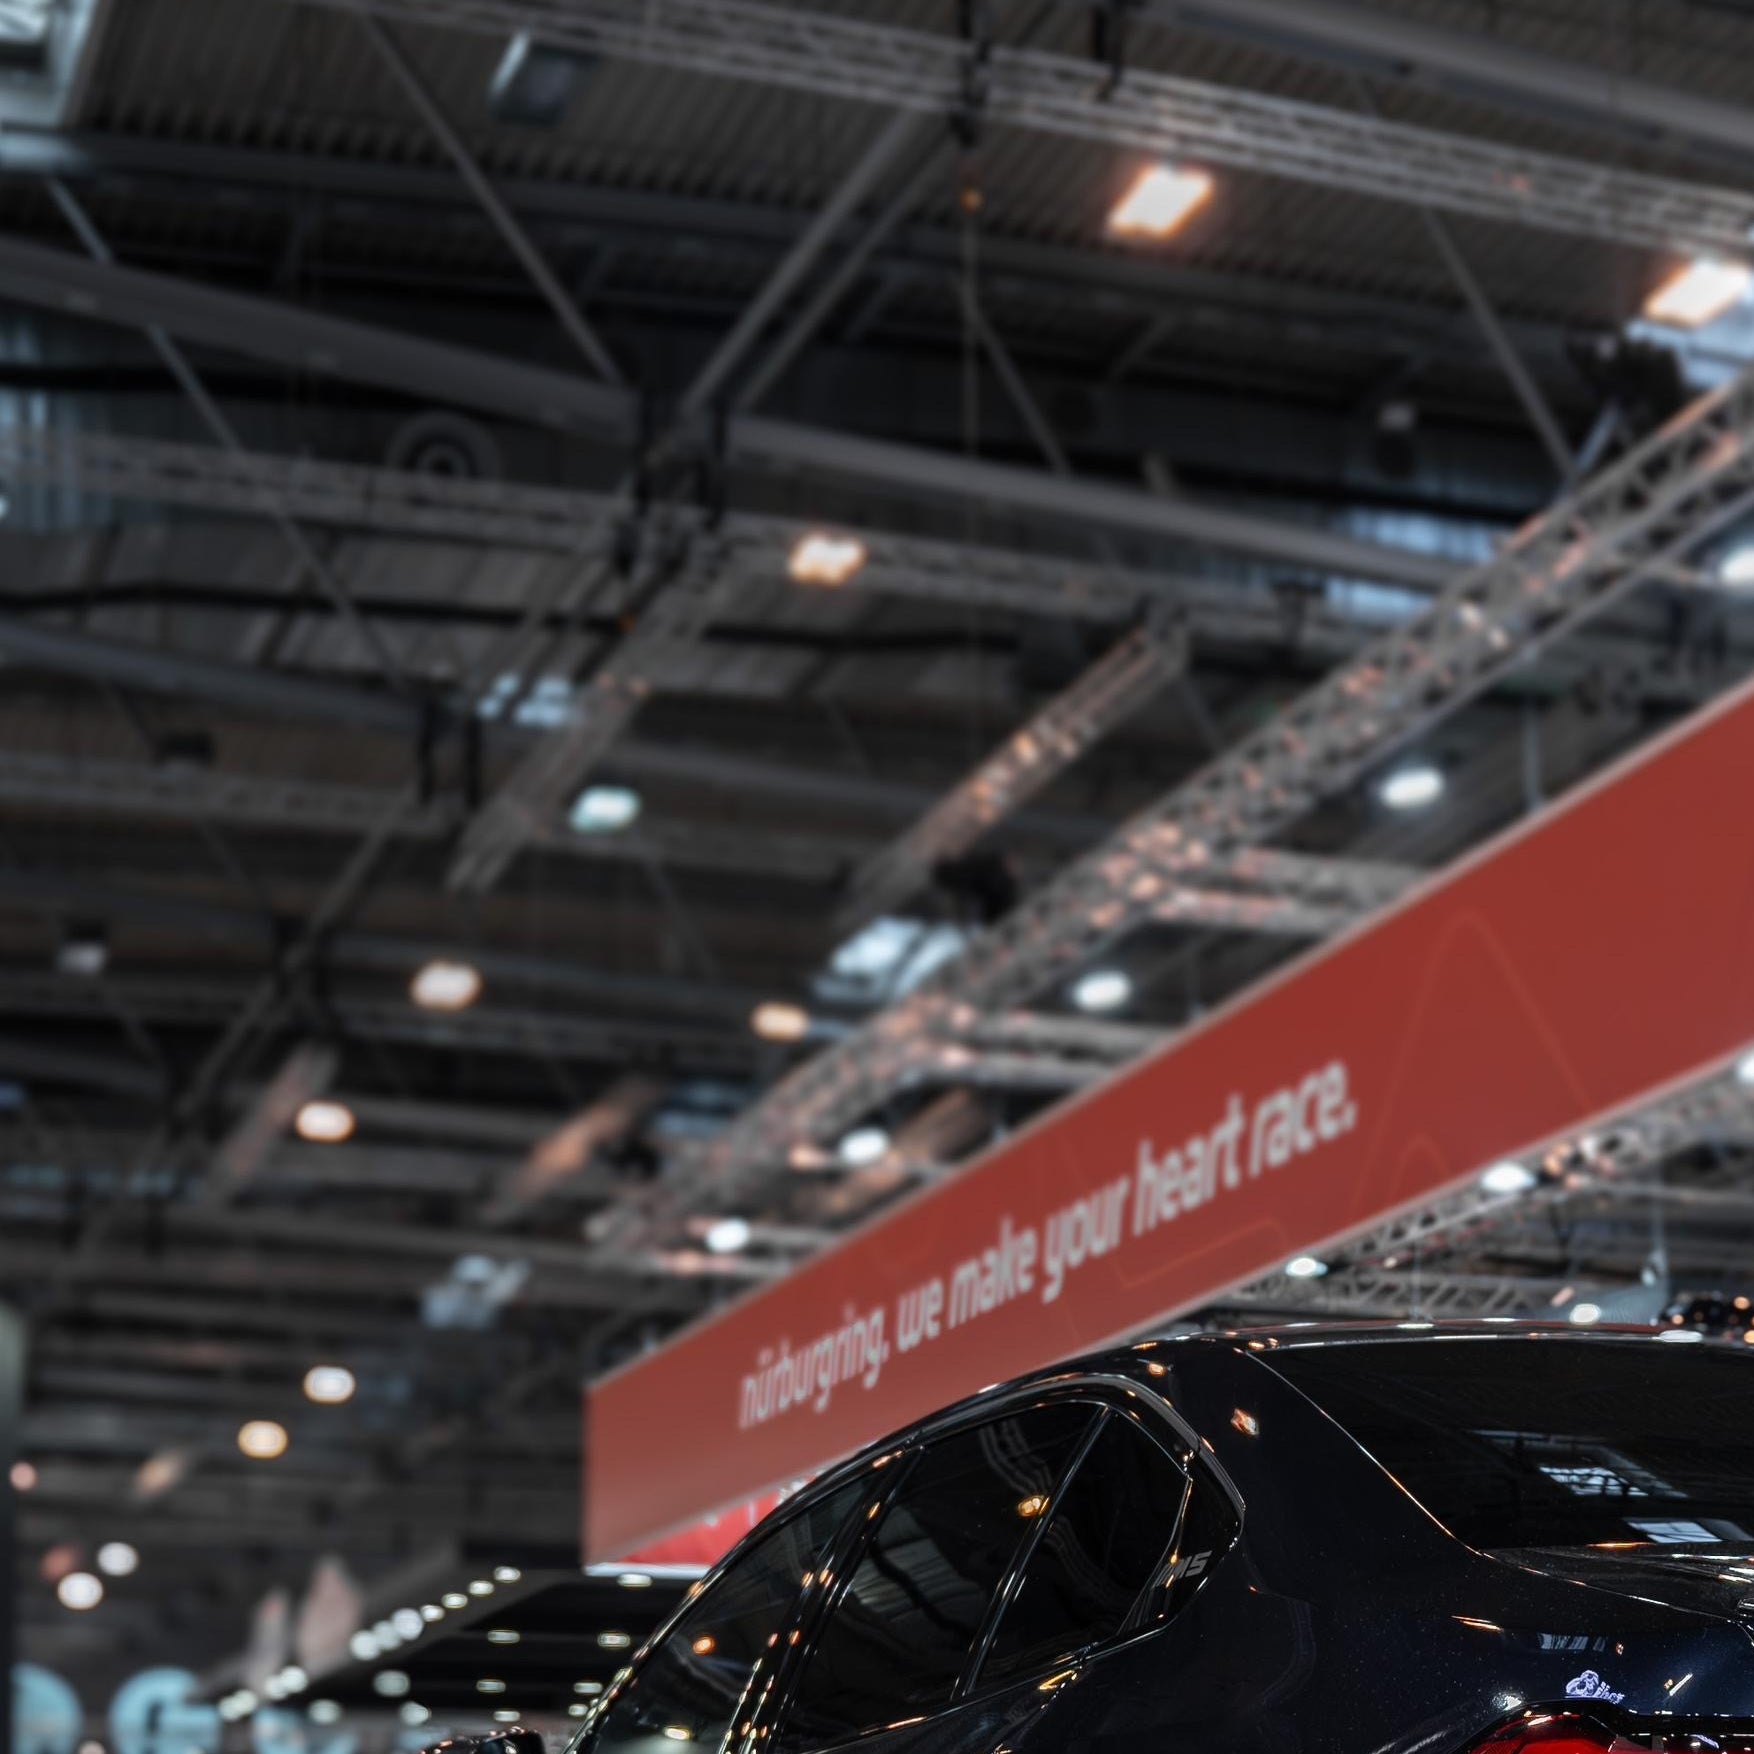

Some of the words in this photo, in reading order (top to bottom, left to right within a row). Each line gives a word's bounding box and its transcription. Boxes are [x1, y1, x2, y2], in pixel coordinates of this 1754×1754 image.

[896, 1276, 942, 1353] we
[948, 1212, 1036, 1330] make
[1042, 1166, 1134, 1305] your
[1132, 1090, 1247, 1236] heart
[1247, 1060, 1358, 1182] race.
